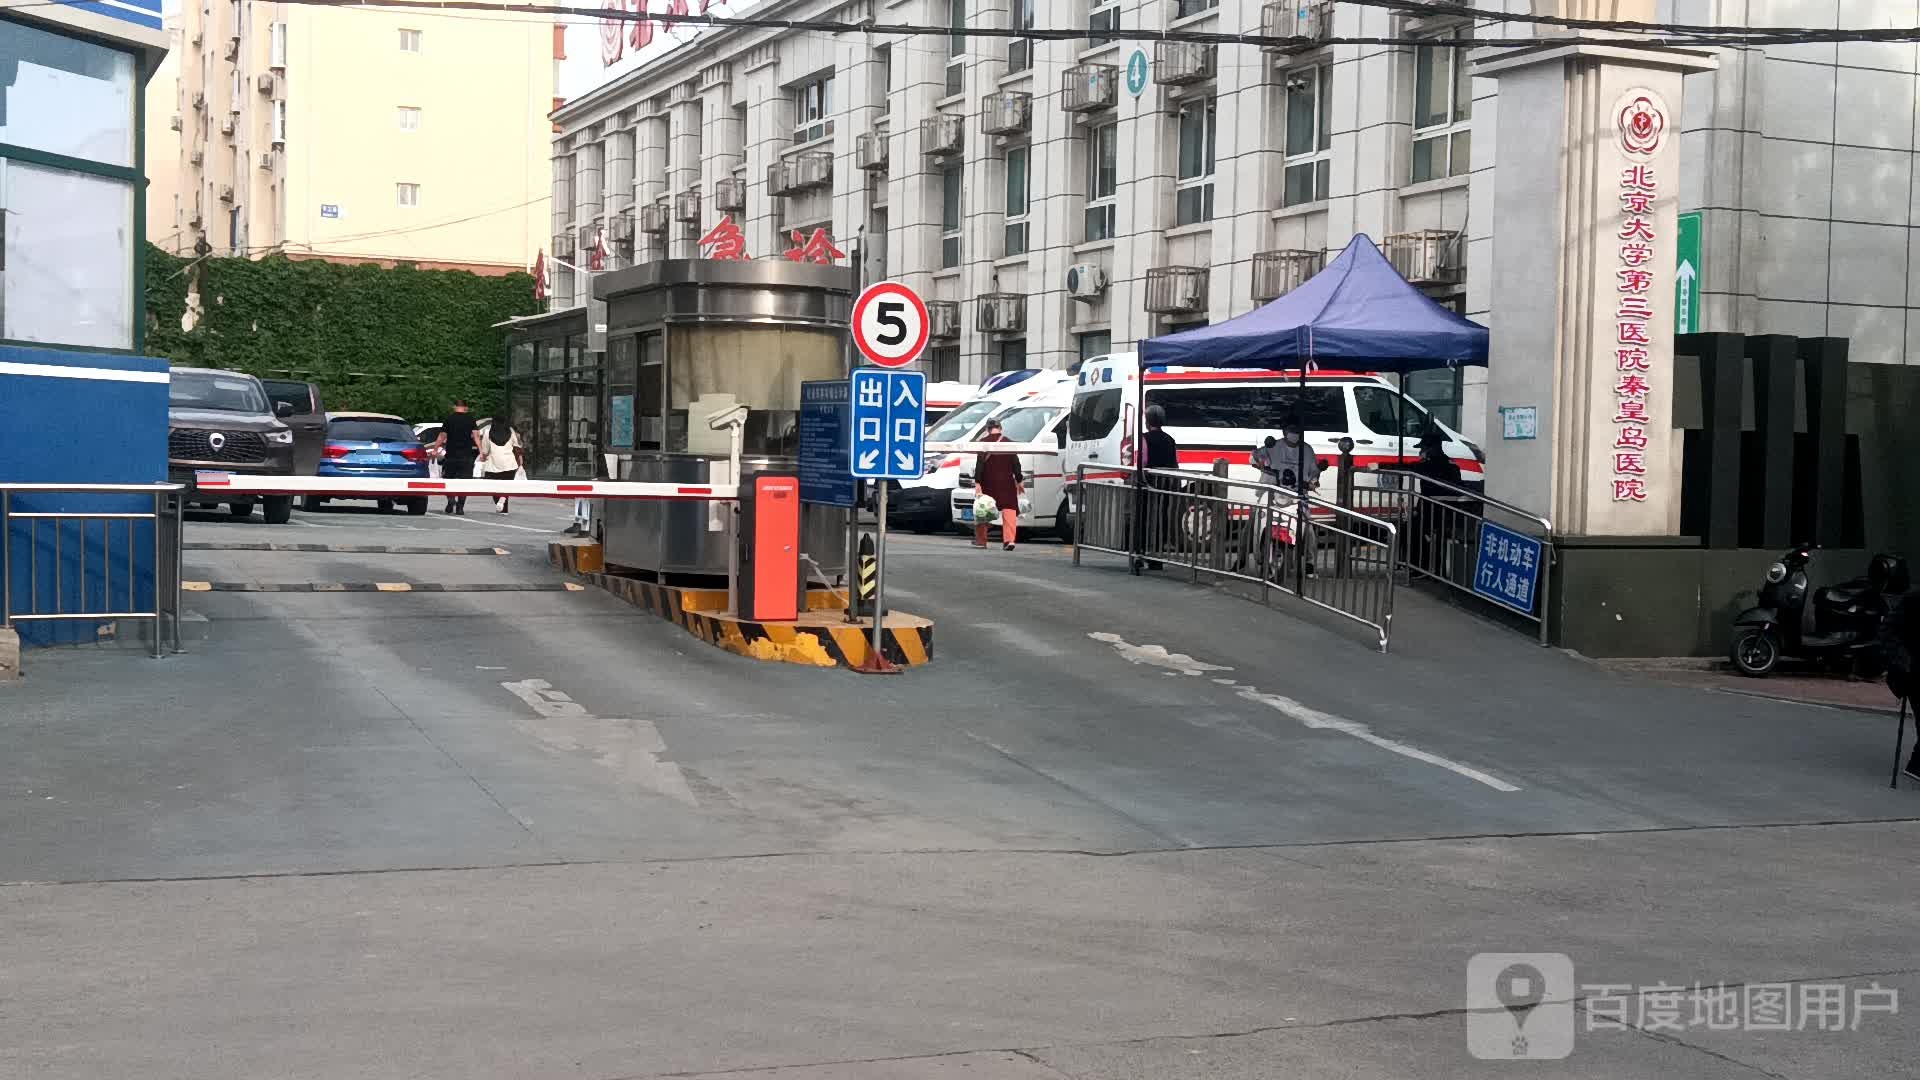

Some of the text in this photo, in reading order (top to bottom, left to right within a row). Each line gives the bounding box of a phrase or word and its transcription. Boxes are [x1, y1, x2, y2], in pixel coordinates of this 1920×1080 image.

[1130, 55, 1141, 88] 4
[876, 301, 907, 346] 5
[1613, 165, 1656, 499] 北京大学第三医院秦皇岛医院
[859, 378, 883, 443] 出口
[894, 379, 919, 443] 入口
[1484, 532, 1535, 572] 非机动车
[1480, 561, 1530, 603] 行人通道
